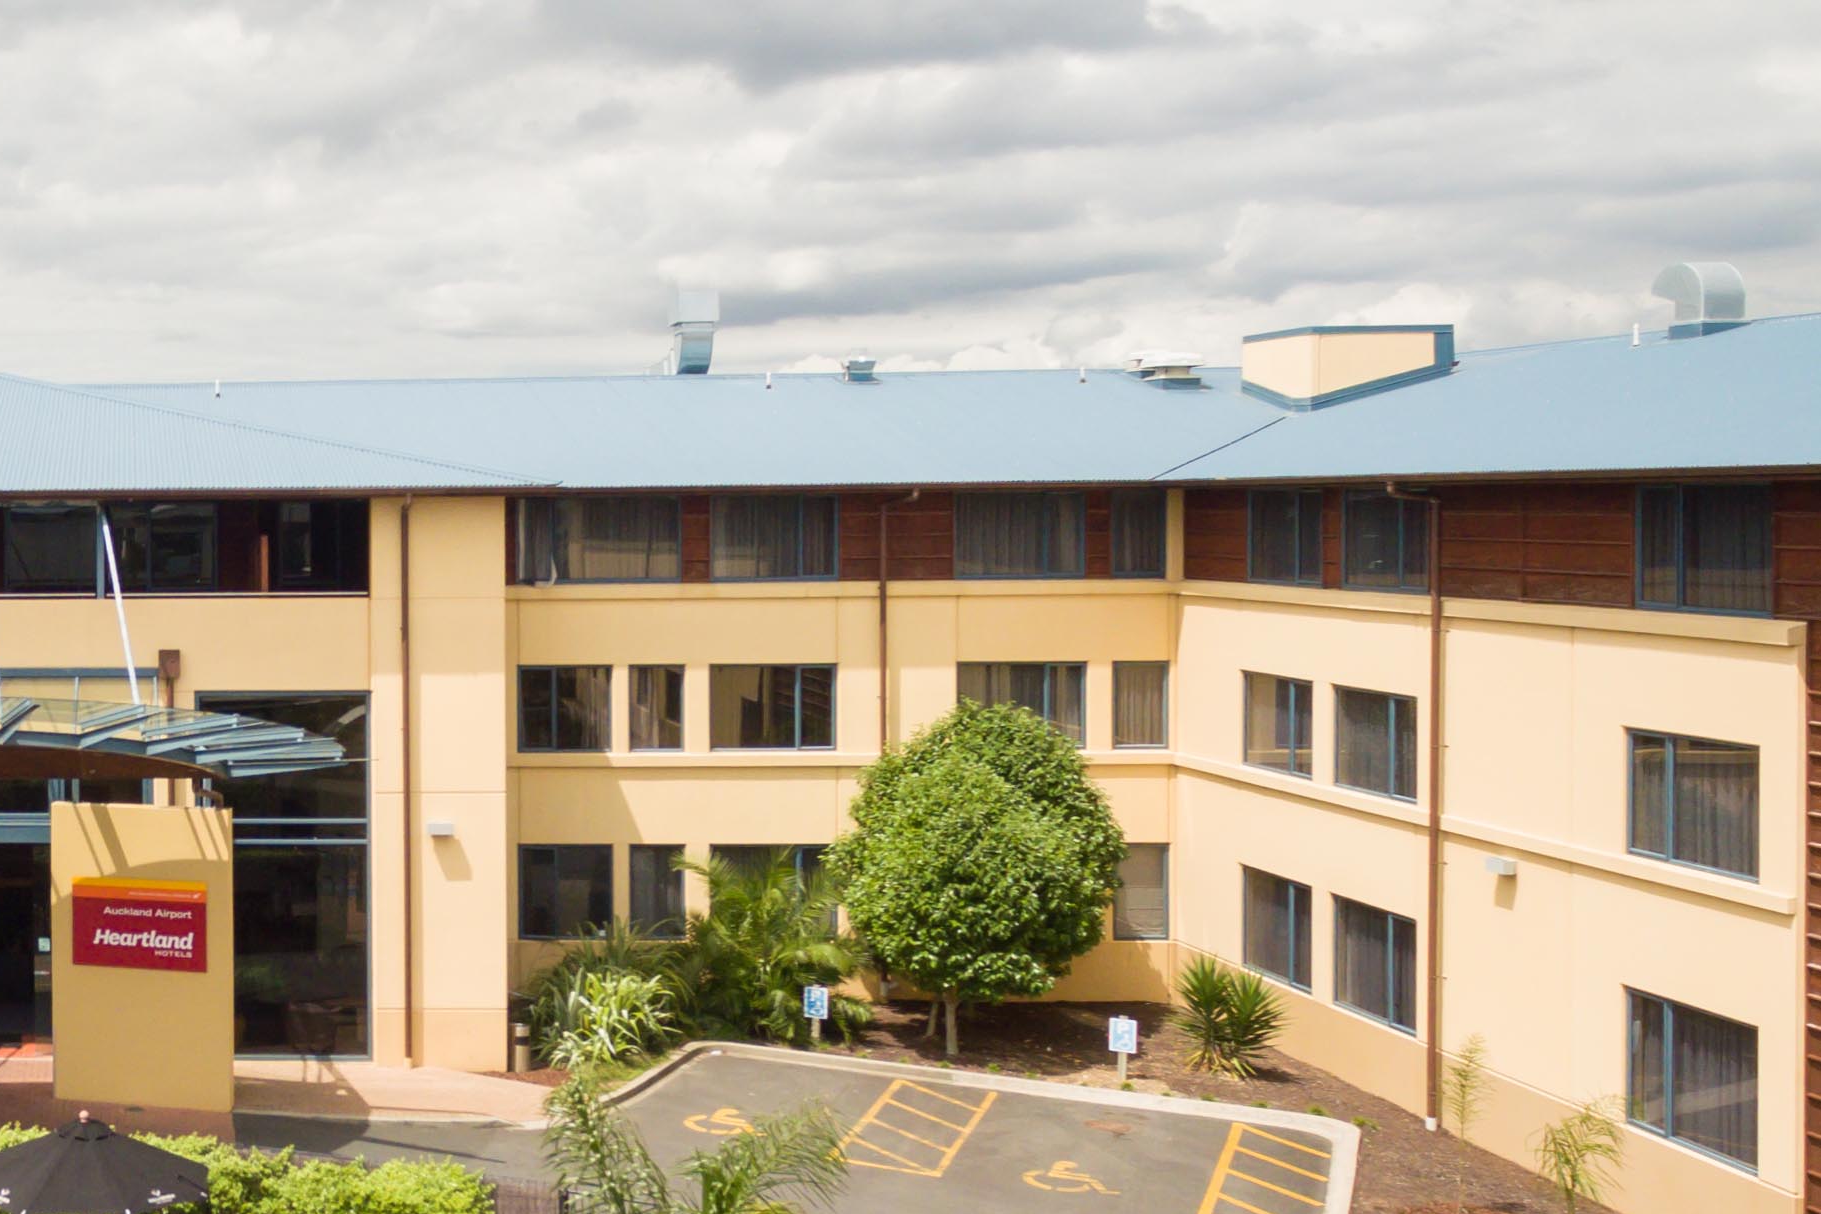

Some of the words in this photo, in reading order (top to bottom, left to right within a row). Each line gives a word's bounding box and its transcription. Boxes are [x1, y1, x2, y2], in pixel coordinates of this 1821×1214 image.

[103, 906, 153, 917] Auckland
[155, 908, 192, 919] Airport
[93, 928, 194, 950] Heartland
[154, 950, 193, 958] HOTELS
